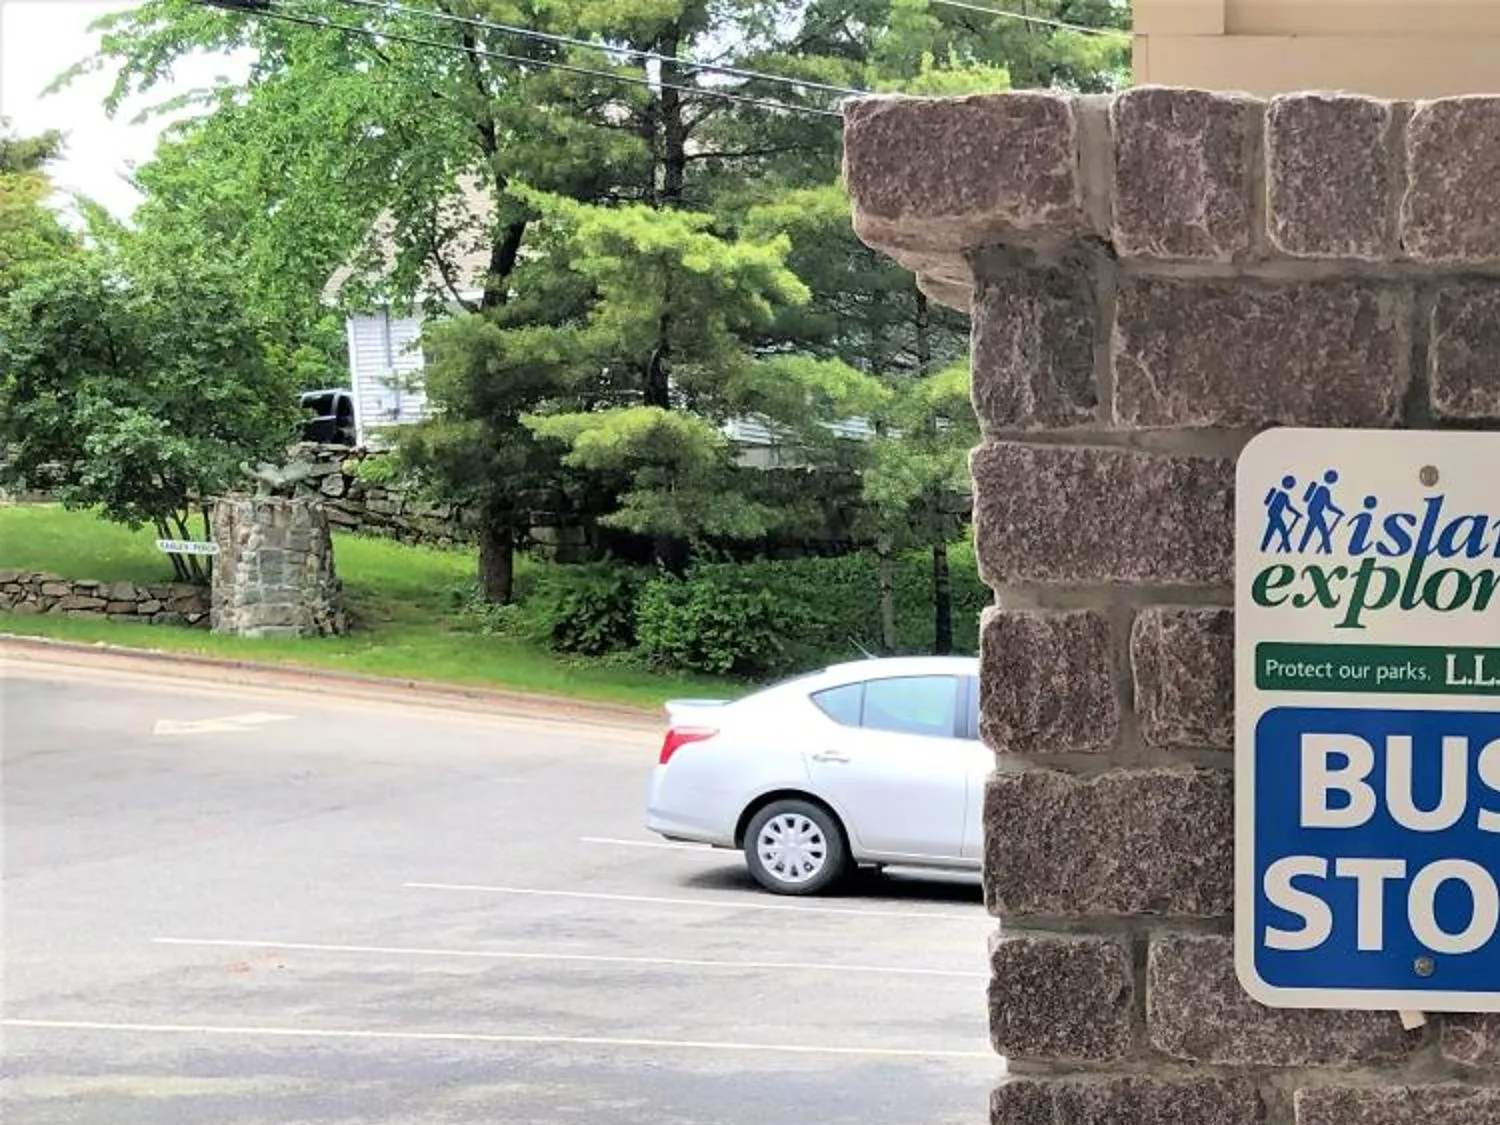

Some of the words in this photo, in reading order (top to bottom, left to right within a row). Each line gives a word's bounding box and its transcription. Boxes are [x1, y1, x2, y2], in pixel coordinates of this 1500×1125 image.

[1265, 659, 1333, 678] Protect
[1339, 664, 1370, 679] our
[1376, 661, 1431, 684] parks.
